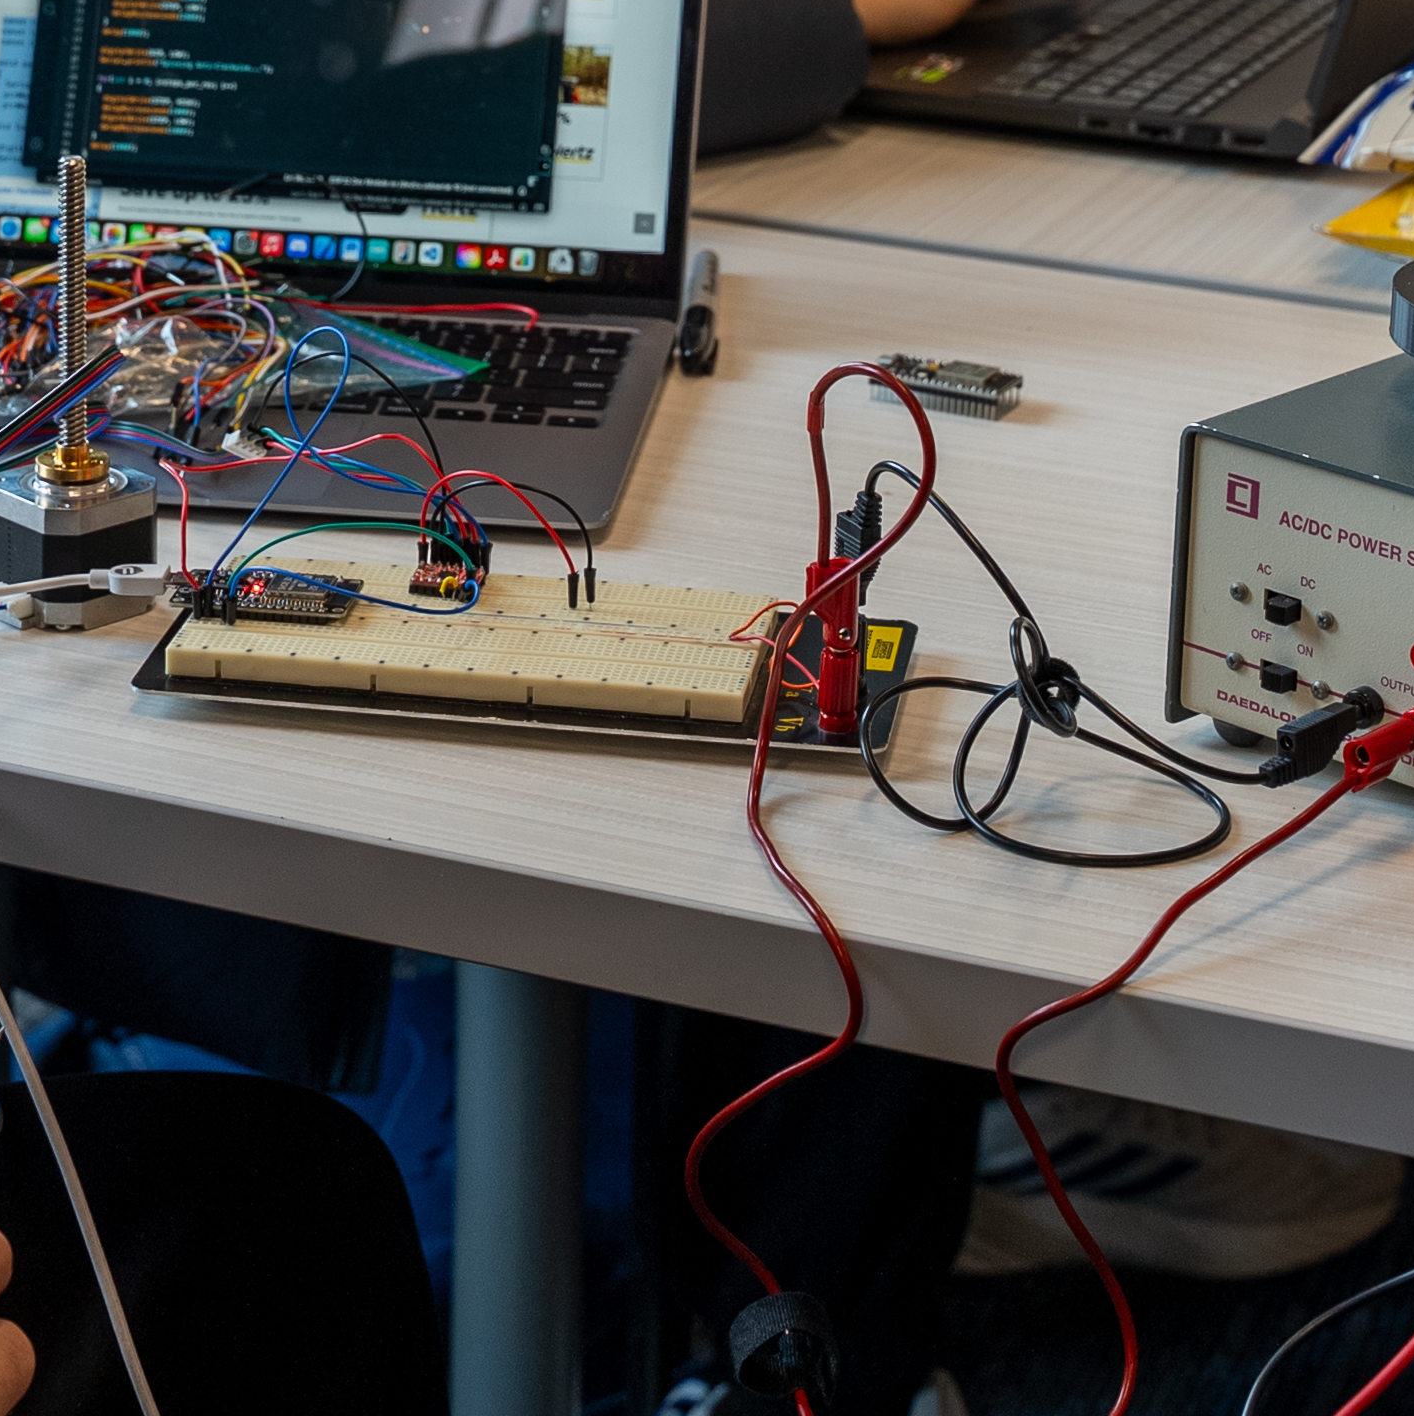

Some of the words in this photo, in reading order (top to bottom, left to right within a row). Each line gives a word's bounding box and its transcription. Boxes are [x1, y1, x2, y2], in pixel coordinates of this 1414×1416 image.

[1278, 511, 1333, 541] AC/DC
[1337, 528, 1402, 563] POWER
[1256, 563, 1272, 576] AC
[1300, 576, 1316, 590] DC
[1250, 629, 1273, 644] OFF
[1296, 643, 1314, 658] ON
[775, 717, 804, 732] Vb
